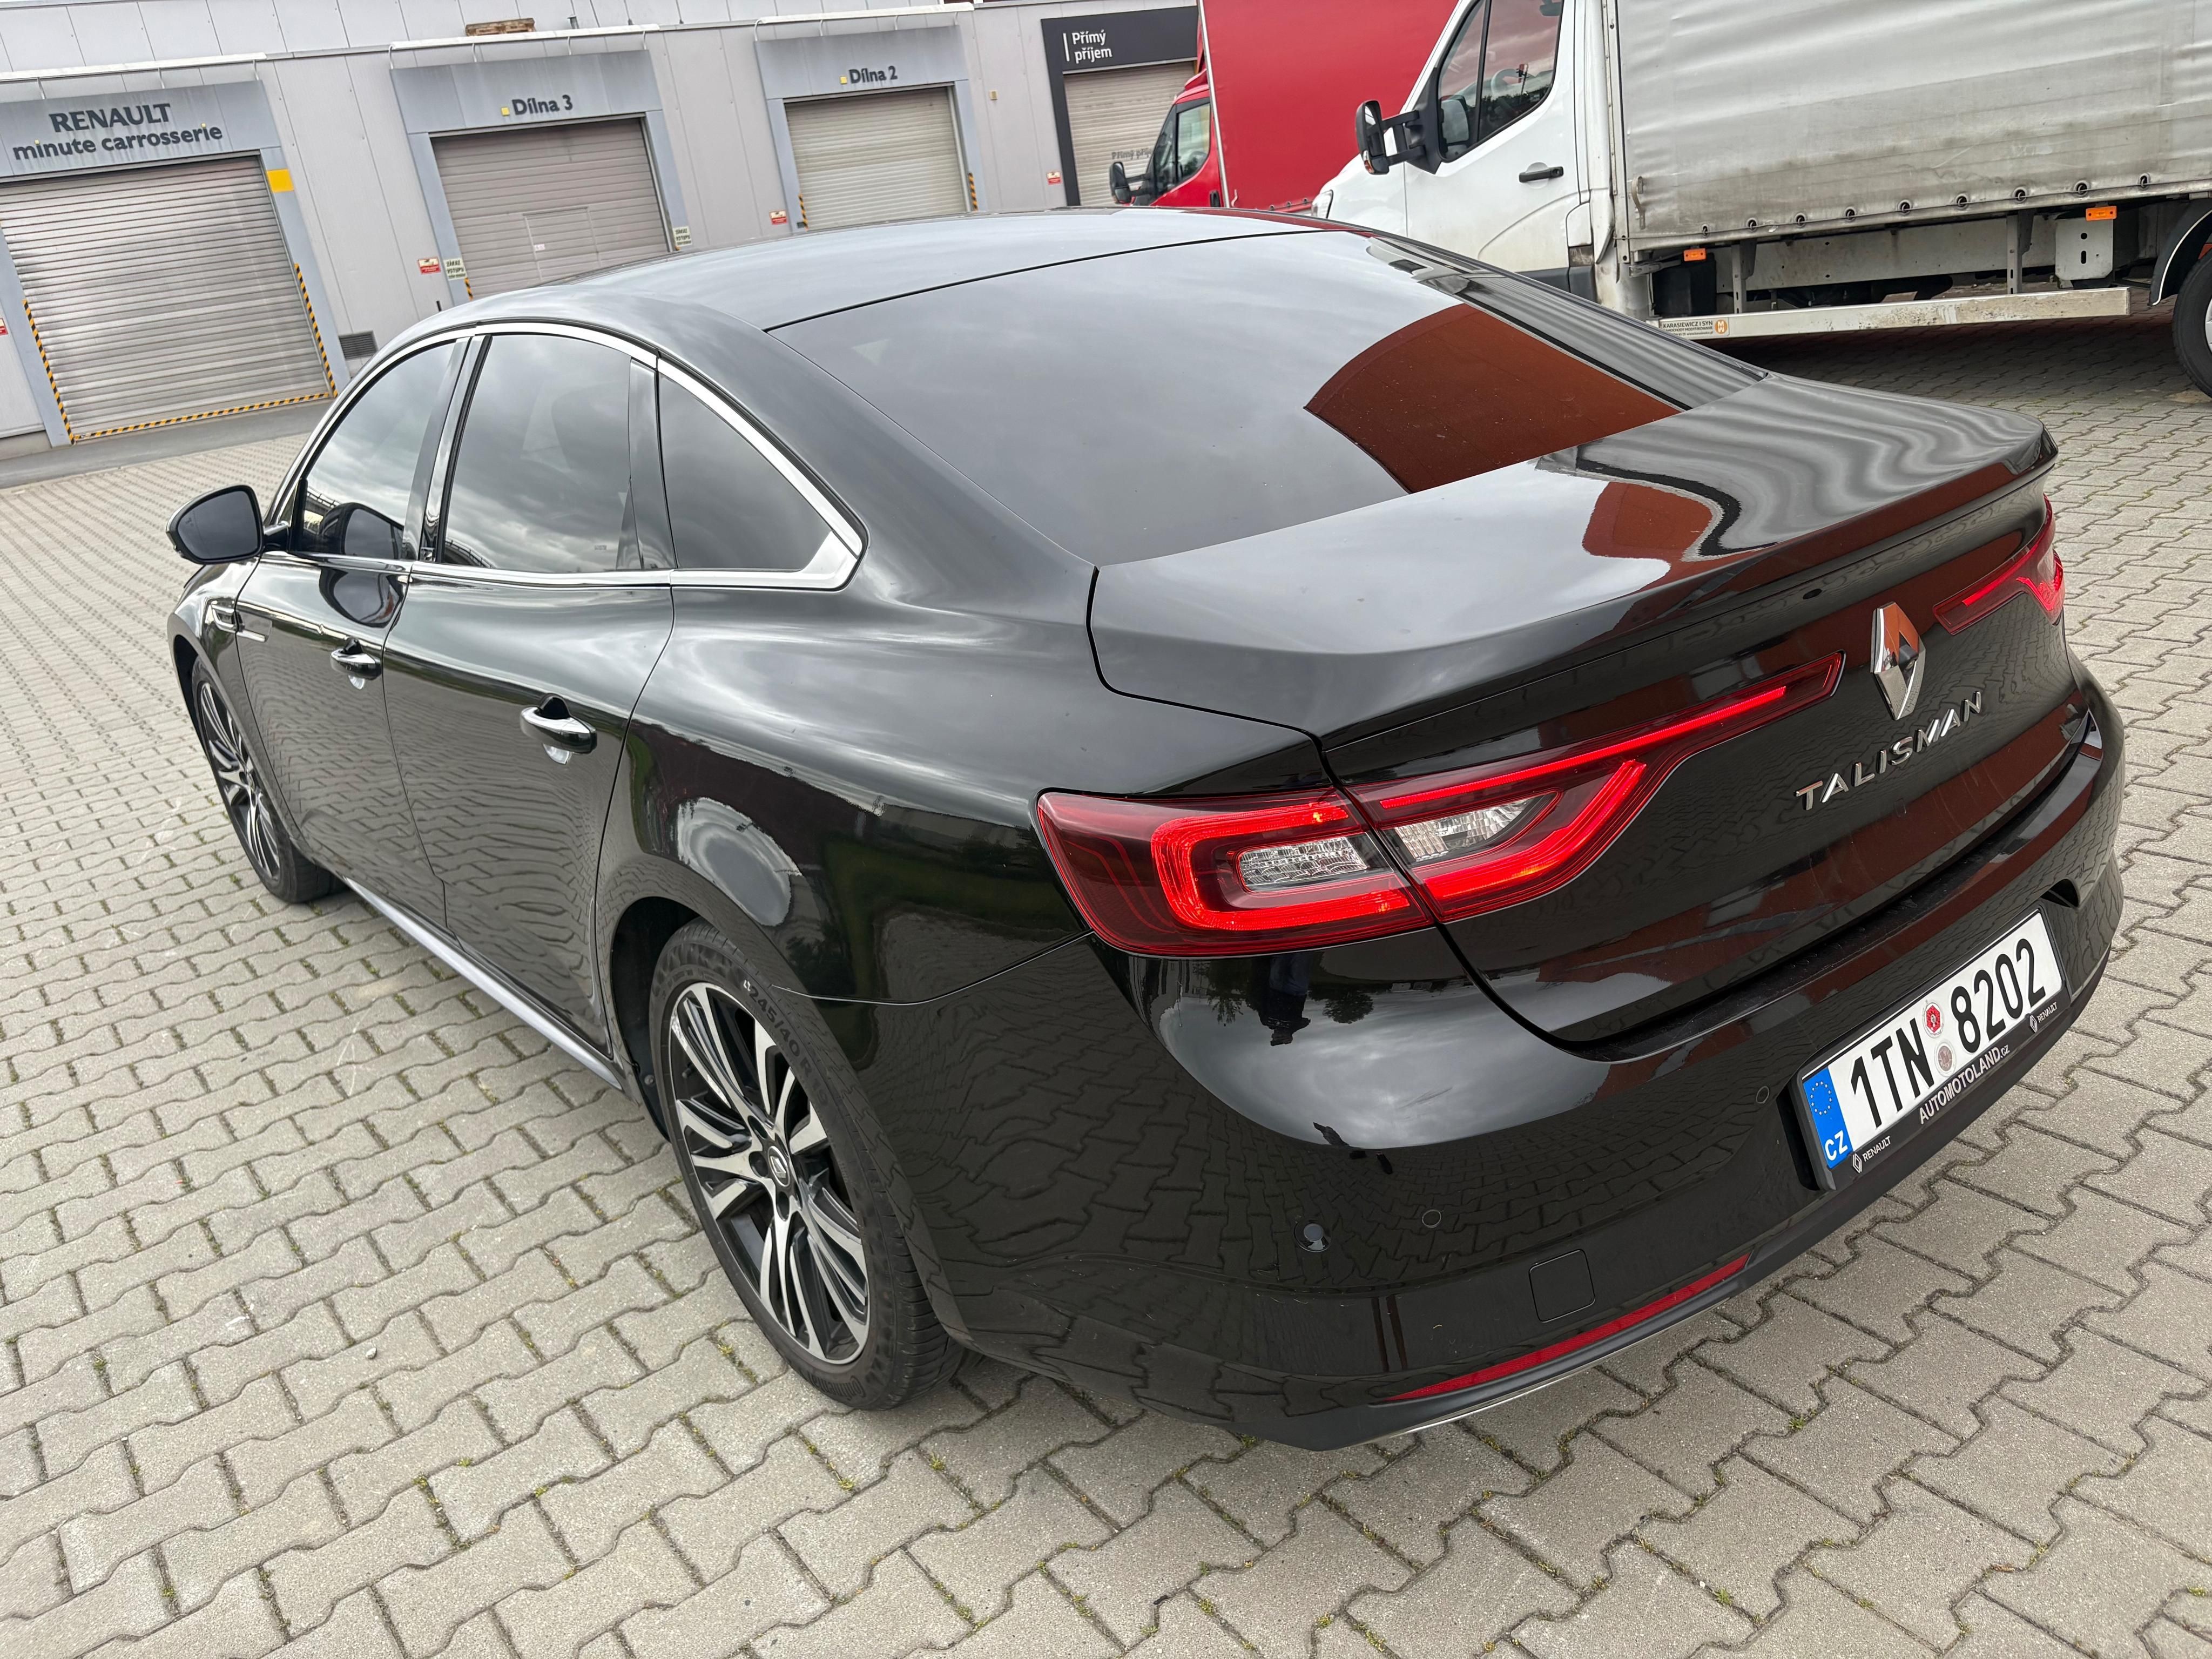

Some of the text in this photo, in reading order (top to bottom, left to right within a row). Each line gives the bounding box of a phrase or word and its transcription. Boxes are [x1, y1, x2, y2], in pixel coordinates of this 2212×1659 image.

[1071, 29, 1106, 45] Přímý
[1074, 47, 1112, 64] příjem
[848, 65, 898, 84] Dílna 2
[49, 103, 170, 132] RENAULT
[511, 95, 573, 115] Dílna 3
[13, 123, 222, 160] minute carrosserie
[1795, 691, 1982, 810] TALISMAN
[2036, 1002, 2058, 1023] RENAULT
[1851, 938, 2046, 1128] 1TN 8202
[1825, 1130, 1848, 1161] CZ
[1862, 1136, 1891, 1162] RENAULT
